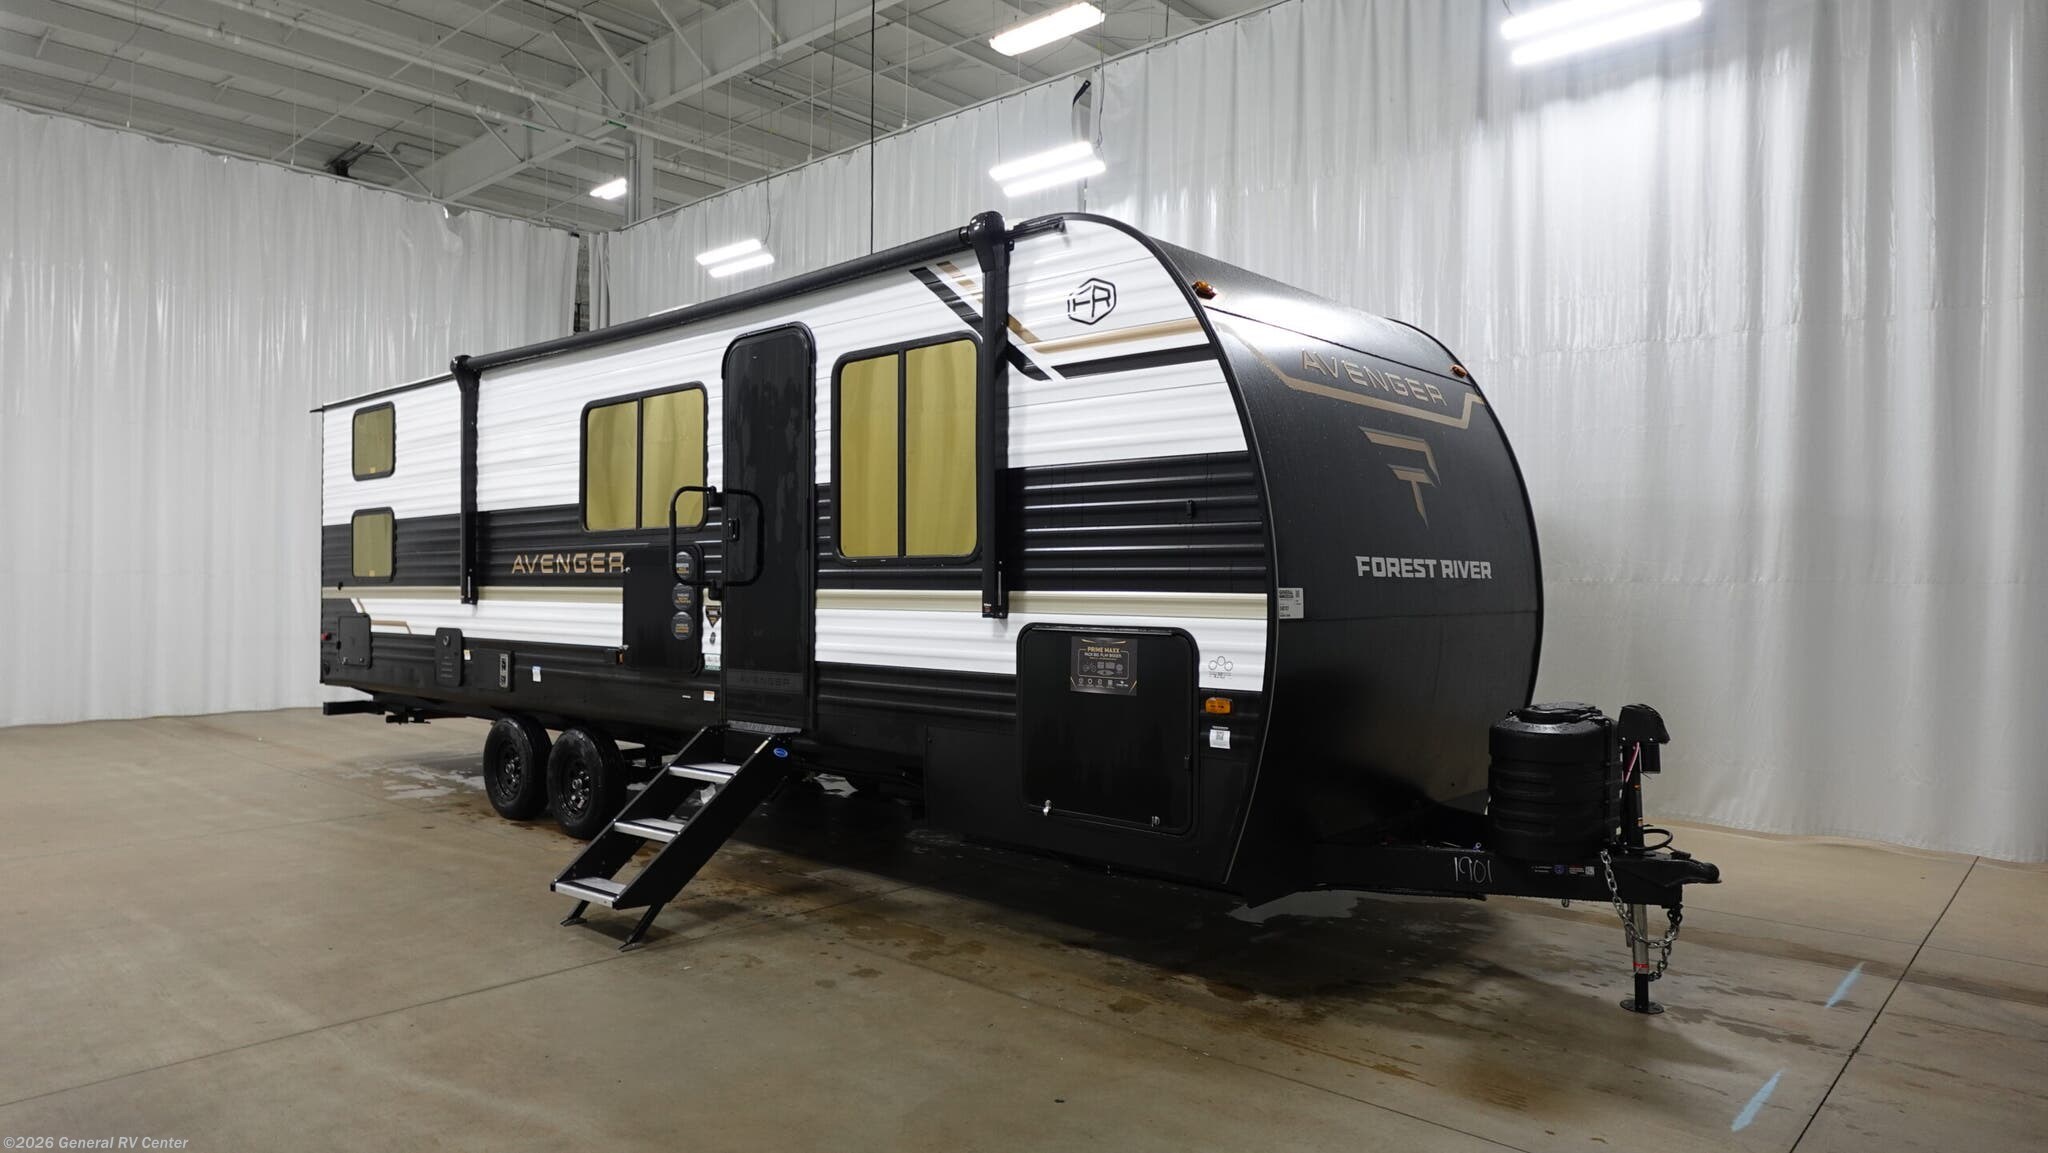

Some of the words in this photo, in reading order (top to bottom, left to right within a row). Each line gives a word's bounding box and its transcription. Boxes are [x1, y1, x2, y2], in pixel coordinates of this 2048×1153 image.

[1301, 348, 1448, 406] AVENGER
[511, 552, 625, 574] AVENGER
[1355, 556, 1437, 578] FOREST
[1439, 559, 1492, 579] RIVER
[1454, 856, 1493, 883] 1901
